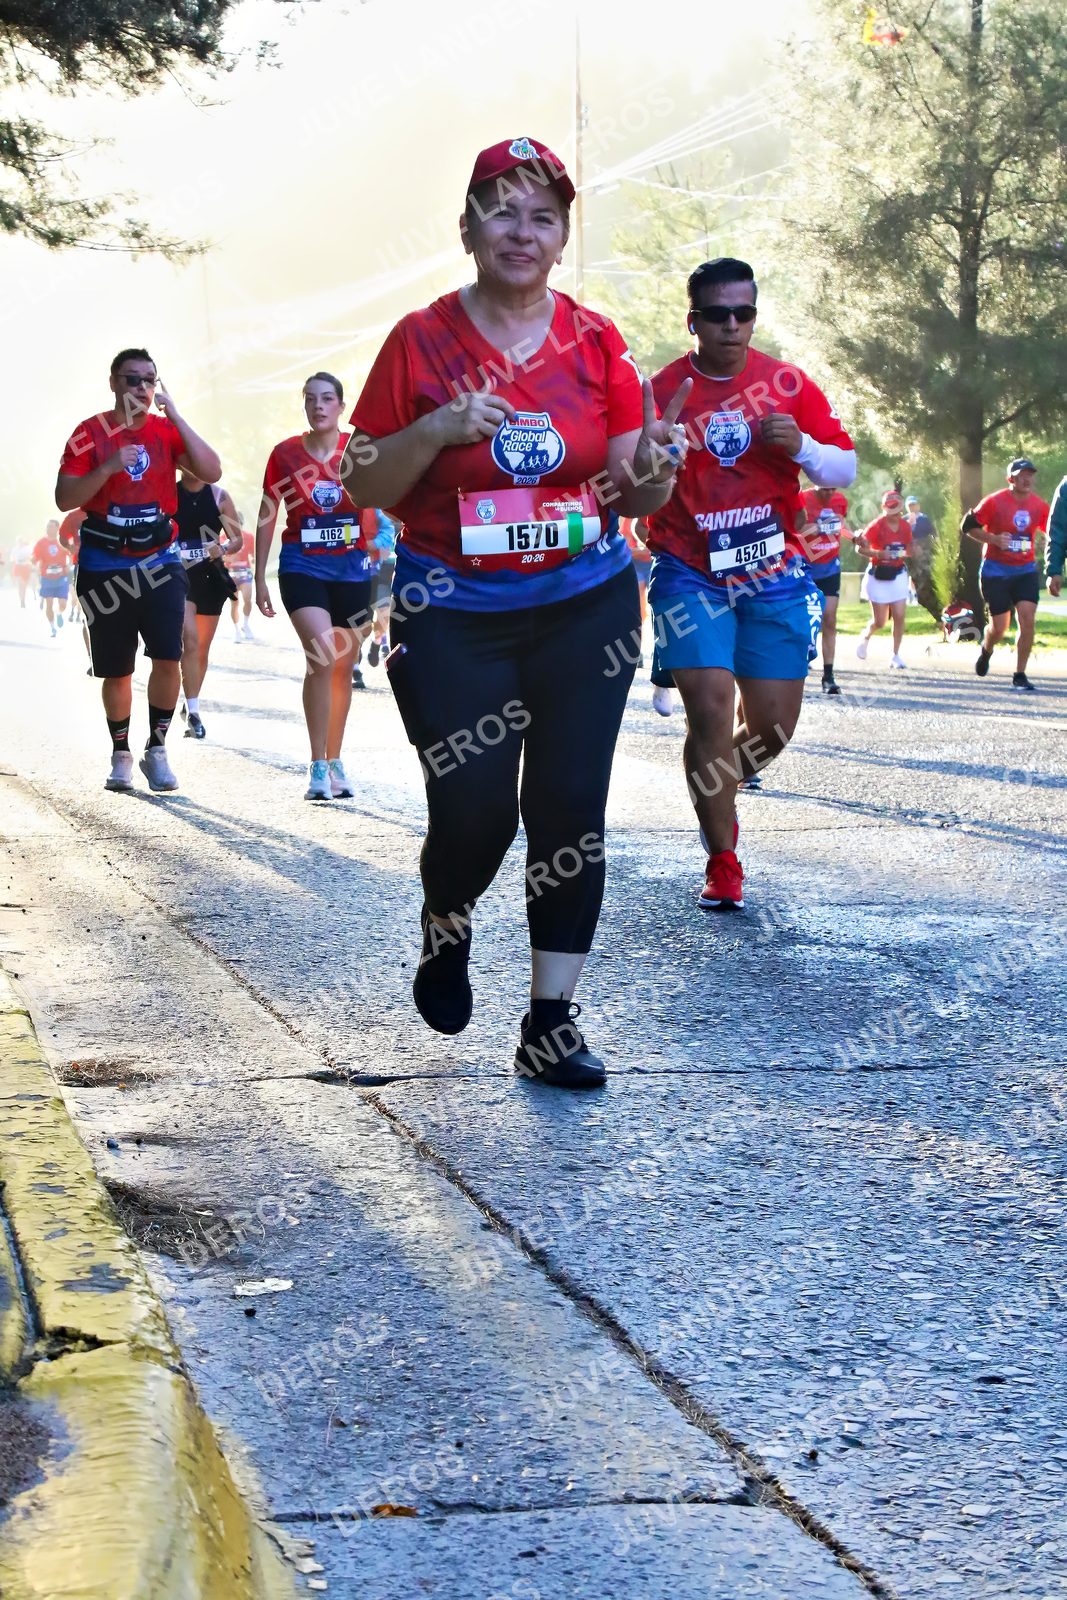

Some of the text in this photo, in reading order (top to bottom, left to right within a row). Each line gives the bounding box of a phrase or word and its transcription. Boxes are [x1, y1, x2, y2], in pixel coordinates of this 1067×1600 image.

[510, 430, 546, 443] Global
[503, 440, 533, 452] Race
[515, 476, 538, 485] 2026
[694, 503, 772, 532] SANTIAGO
[320, 528, 343, 541] 4162
[506, 522, 559, 551] 1570
[735, 540, 767, 565] 4520
